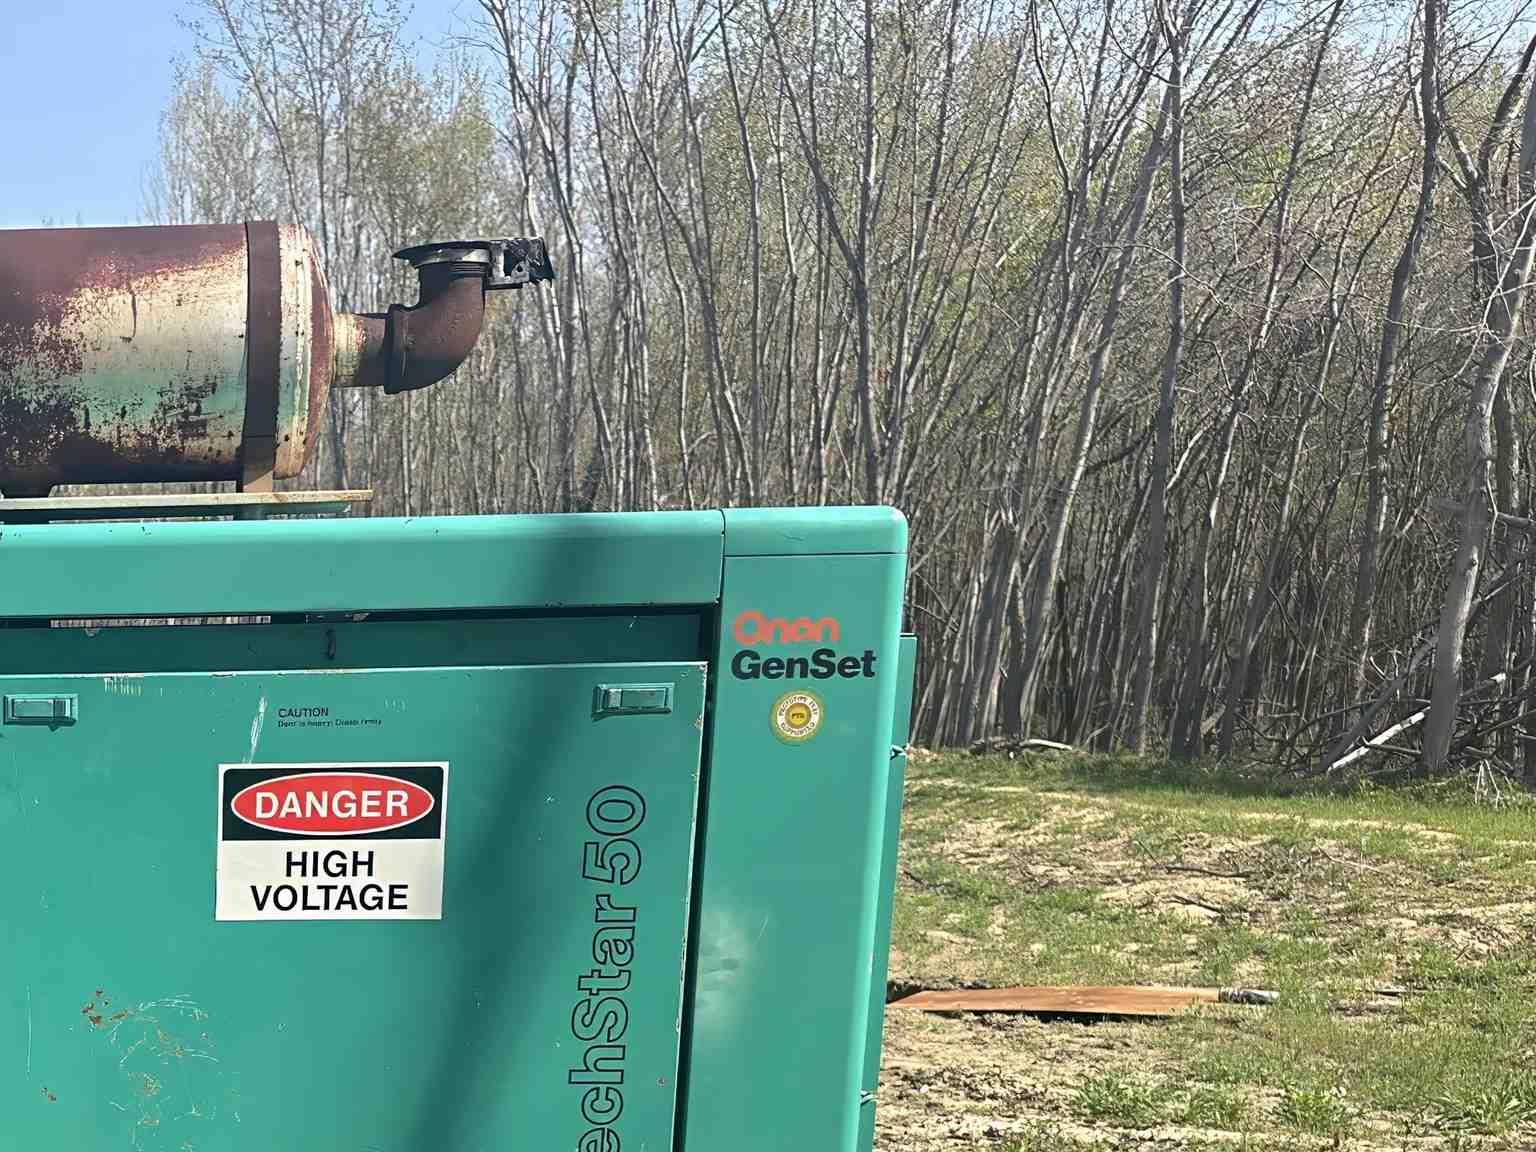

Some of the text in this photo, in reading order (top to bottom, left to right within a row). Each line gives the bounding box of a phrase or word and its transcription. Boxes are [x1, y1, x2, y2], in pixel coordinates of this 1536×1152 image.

[733, 611, 840, 645] Onan
[731, 649, 877, 680] GenSet
[278, 707, 329, 718] CAUTION
[255, 790, 408, 819] DANGER
[582, 785, 646, 886] 50
[285, 850, 375, 878] HIGH
[250, 884, 408, 911] VOLTAGE
